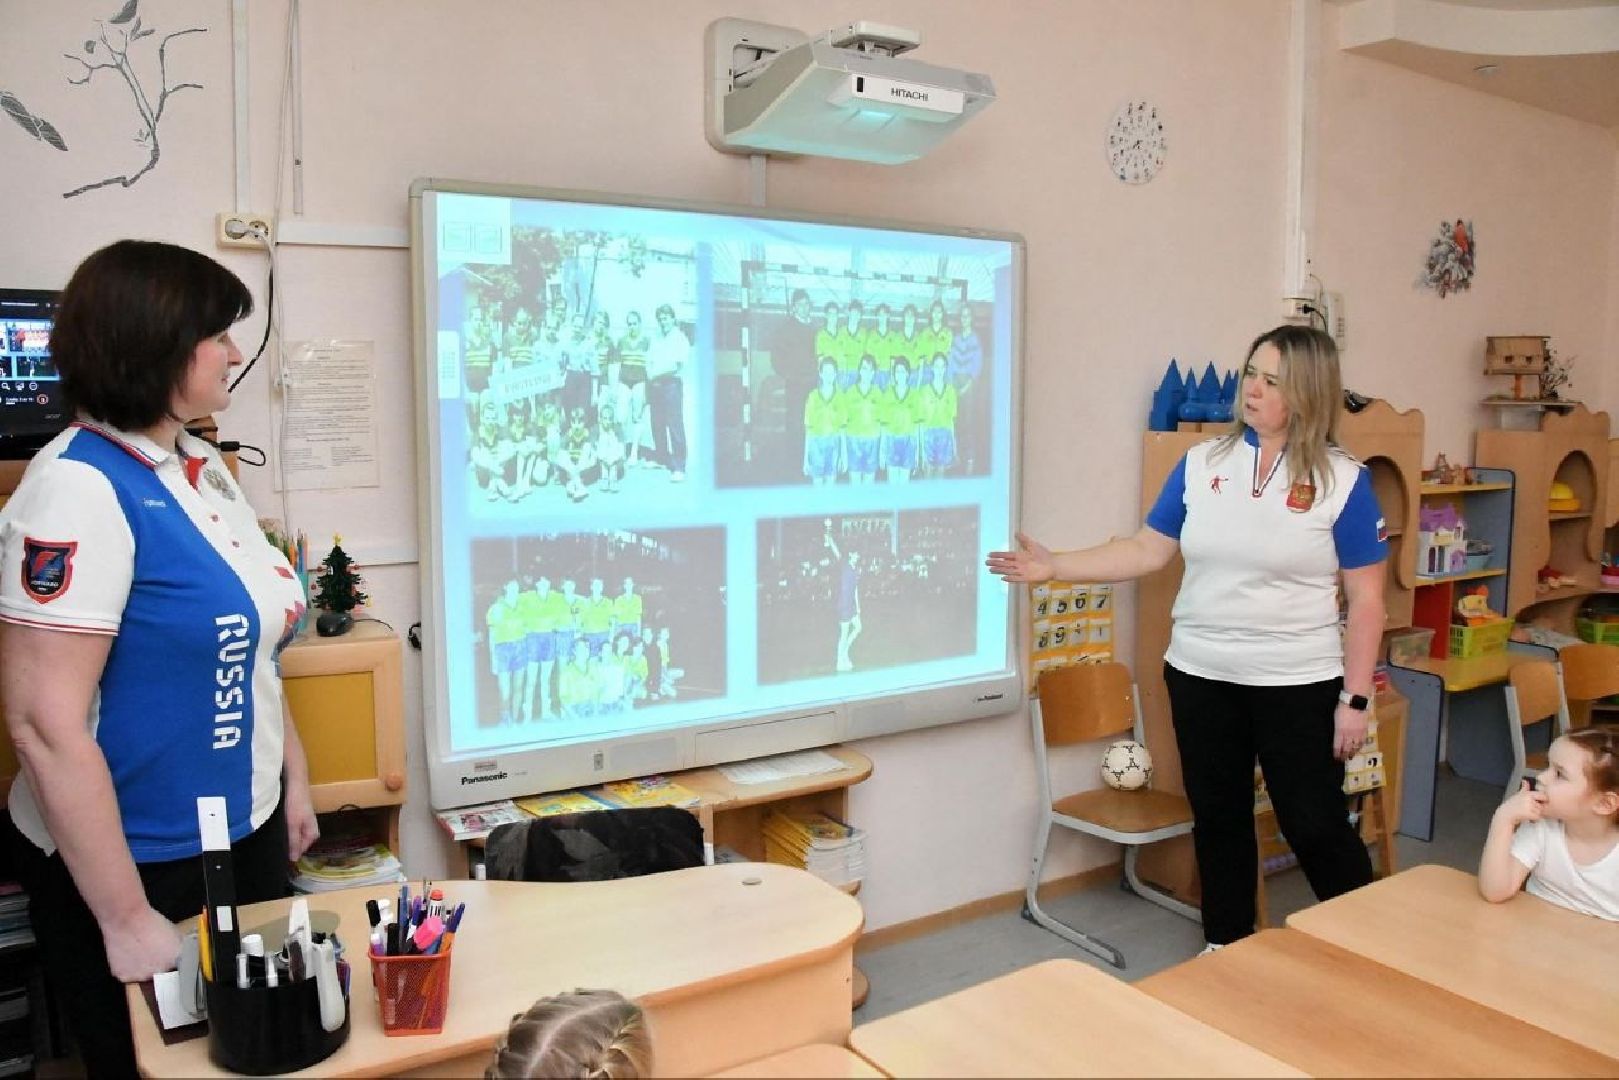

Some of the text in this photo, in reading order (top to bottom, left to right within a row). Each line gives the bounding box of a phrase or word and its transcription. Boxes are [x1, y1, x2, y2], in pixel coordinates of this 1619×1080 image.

[891, 88, 928, 101] HITACHI
[1037, 599, 1047, 614] 4
[1057, 600, 1067, 613] 5
[213, 614, 250, 749] RUSSIA
[461, 771, 508, 785] Panasonic
